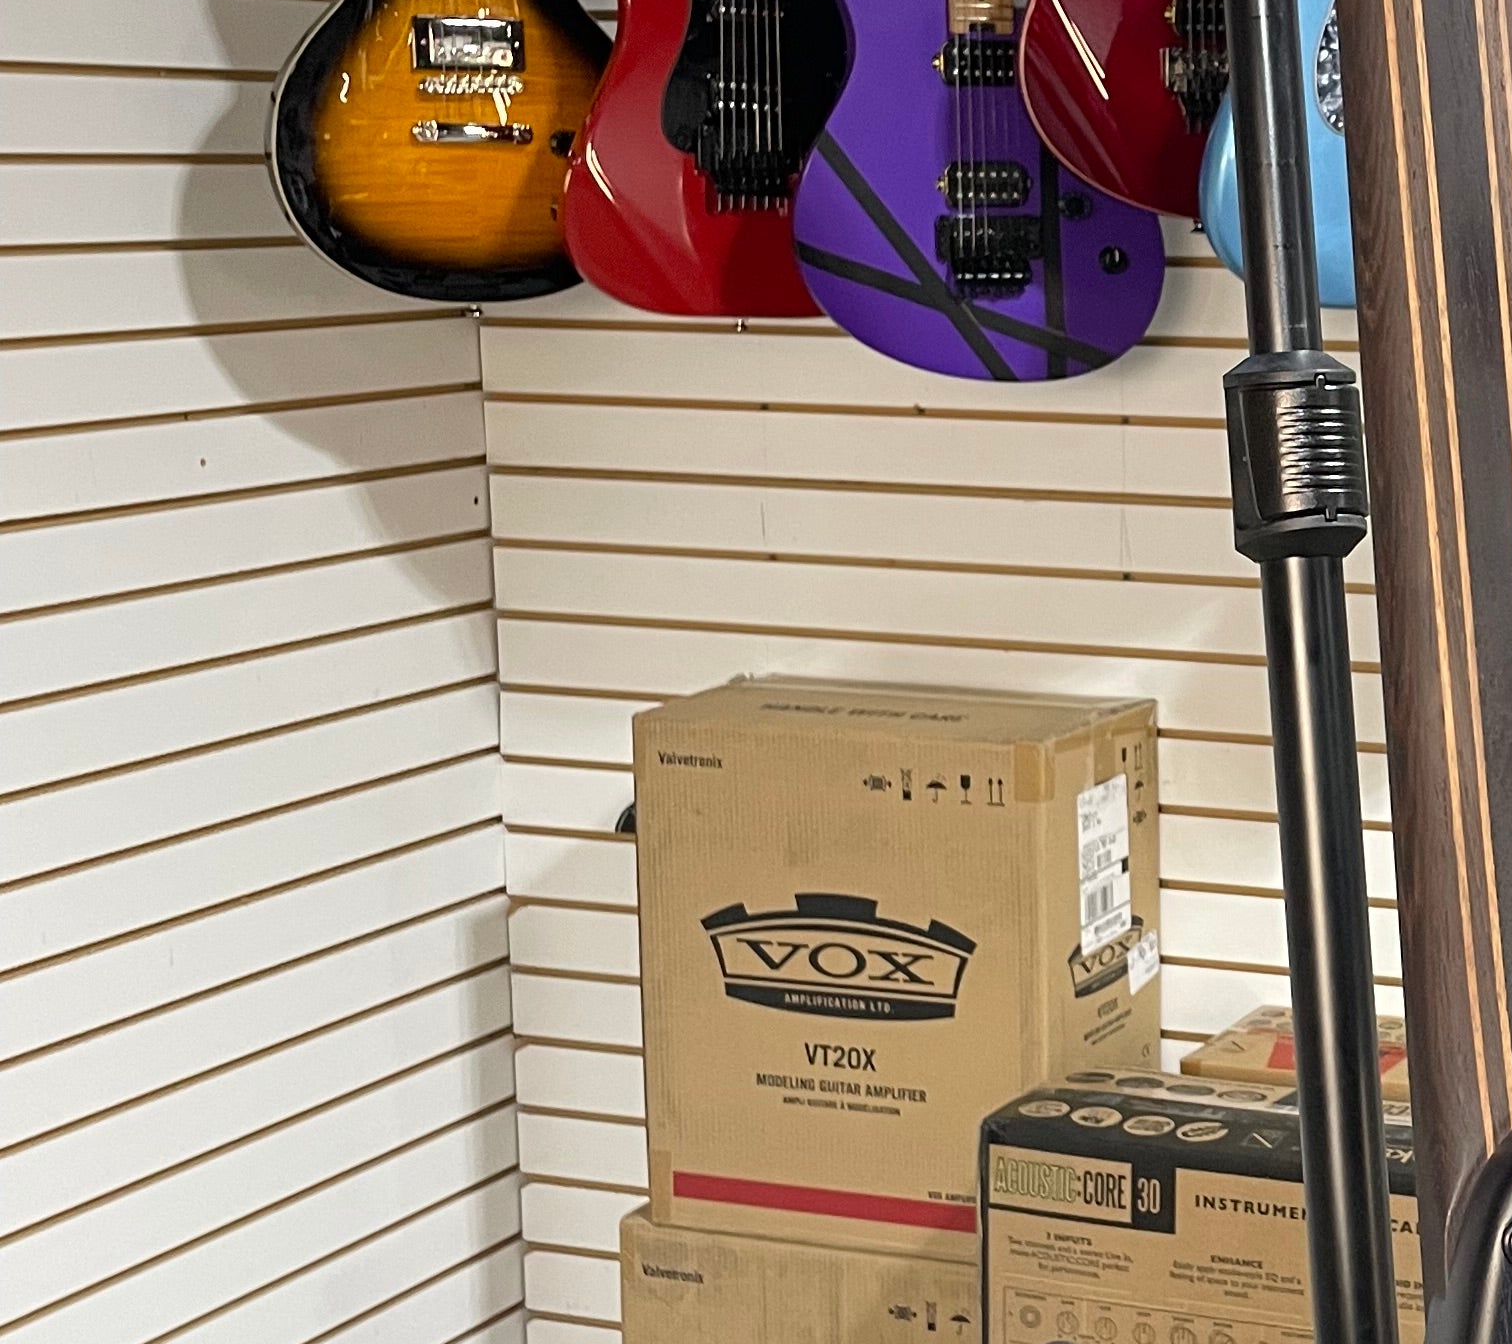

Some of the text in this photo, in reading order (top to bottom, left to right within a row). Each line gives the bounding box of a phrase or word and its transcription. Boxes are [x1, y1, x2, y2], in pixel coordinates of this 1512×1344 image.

[658, 749, 724, 770] Valvetronix
[736, 937, 936, 987] VOX
[784, 992, 895, 1014] AMPLIFICATION LTD.
[804, 1042, 878, 1072] VT20X
[756, 1072, 927, 1104] MODELING GUITAR AMPLIFIER
[1137, 1178, 1162, 1214] 30
[1194, 1193, 1306, 1221] INSTRUME
[1210, 1254, 1263, 1270] ENHANCE
